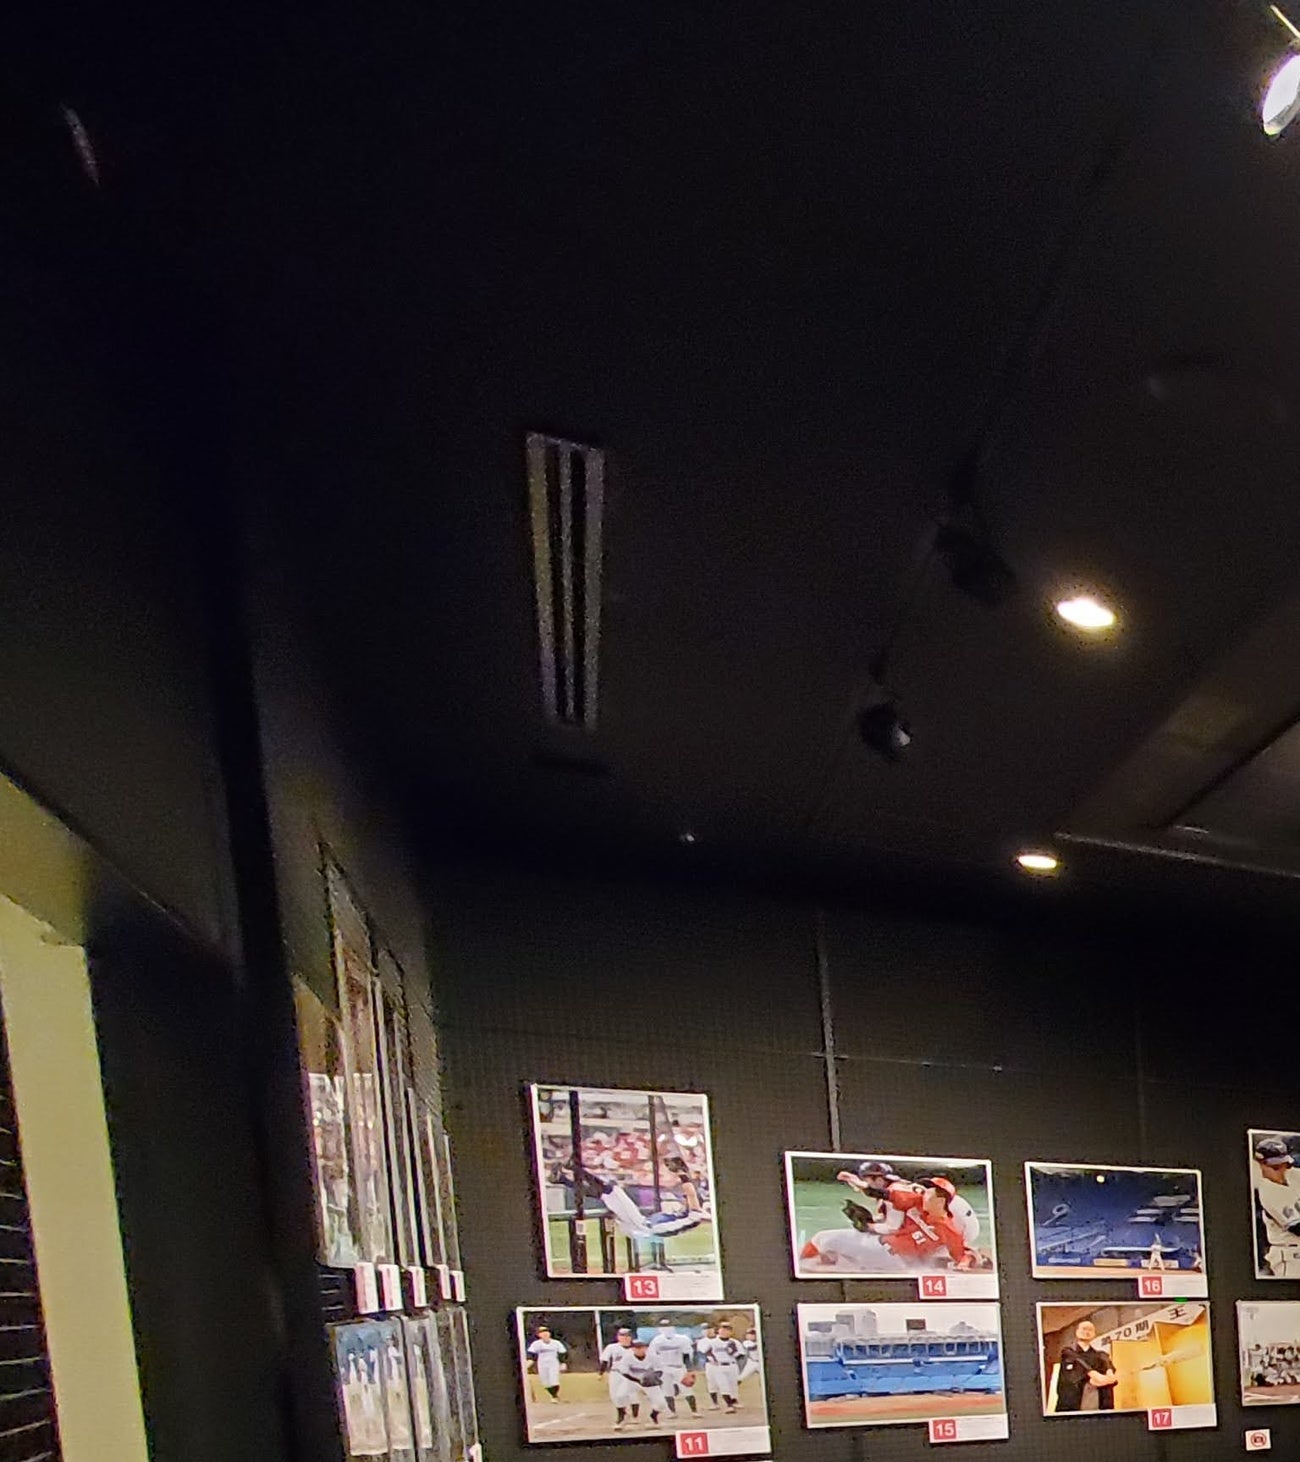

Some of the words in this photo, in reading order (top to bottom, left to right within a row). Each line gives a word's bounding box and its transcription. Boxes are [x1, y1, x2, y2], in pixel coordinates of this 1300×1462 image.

[632, 1279, 658, 1296] 13
[924, 1279, 945, 1293] 14
[1142, 1278, 1161, 1293] 16
[1153, 1410, 1170, 1426] 17
[934, 1421, 955, 1438] 15
[683, 1436, 703, 1452] 11
